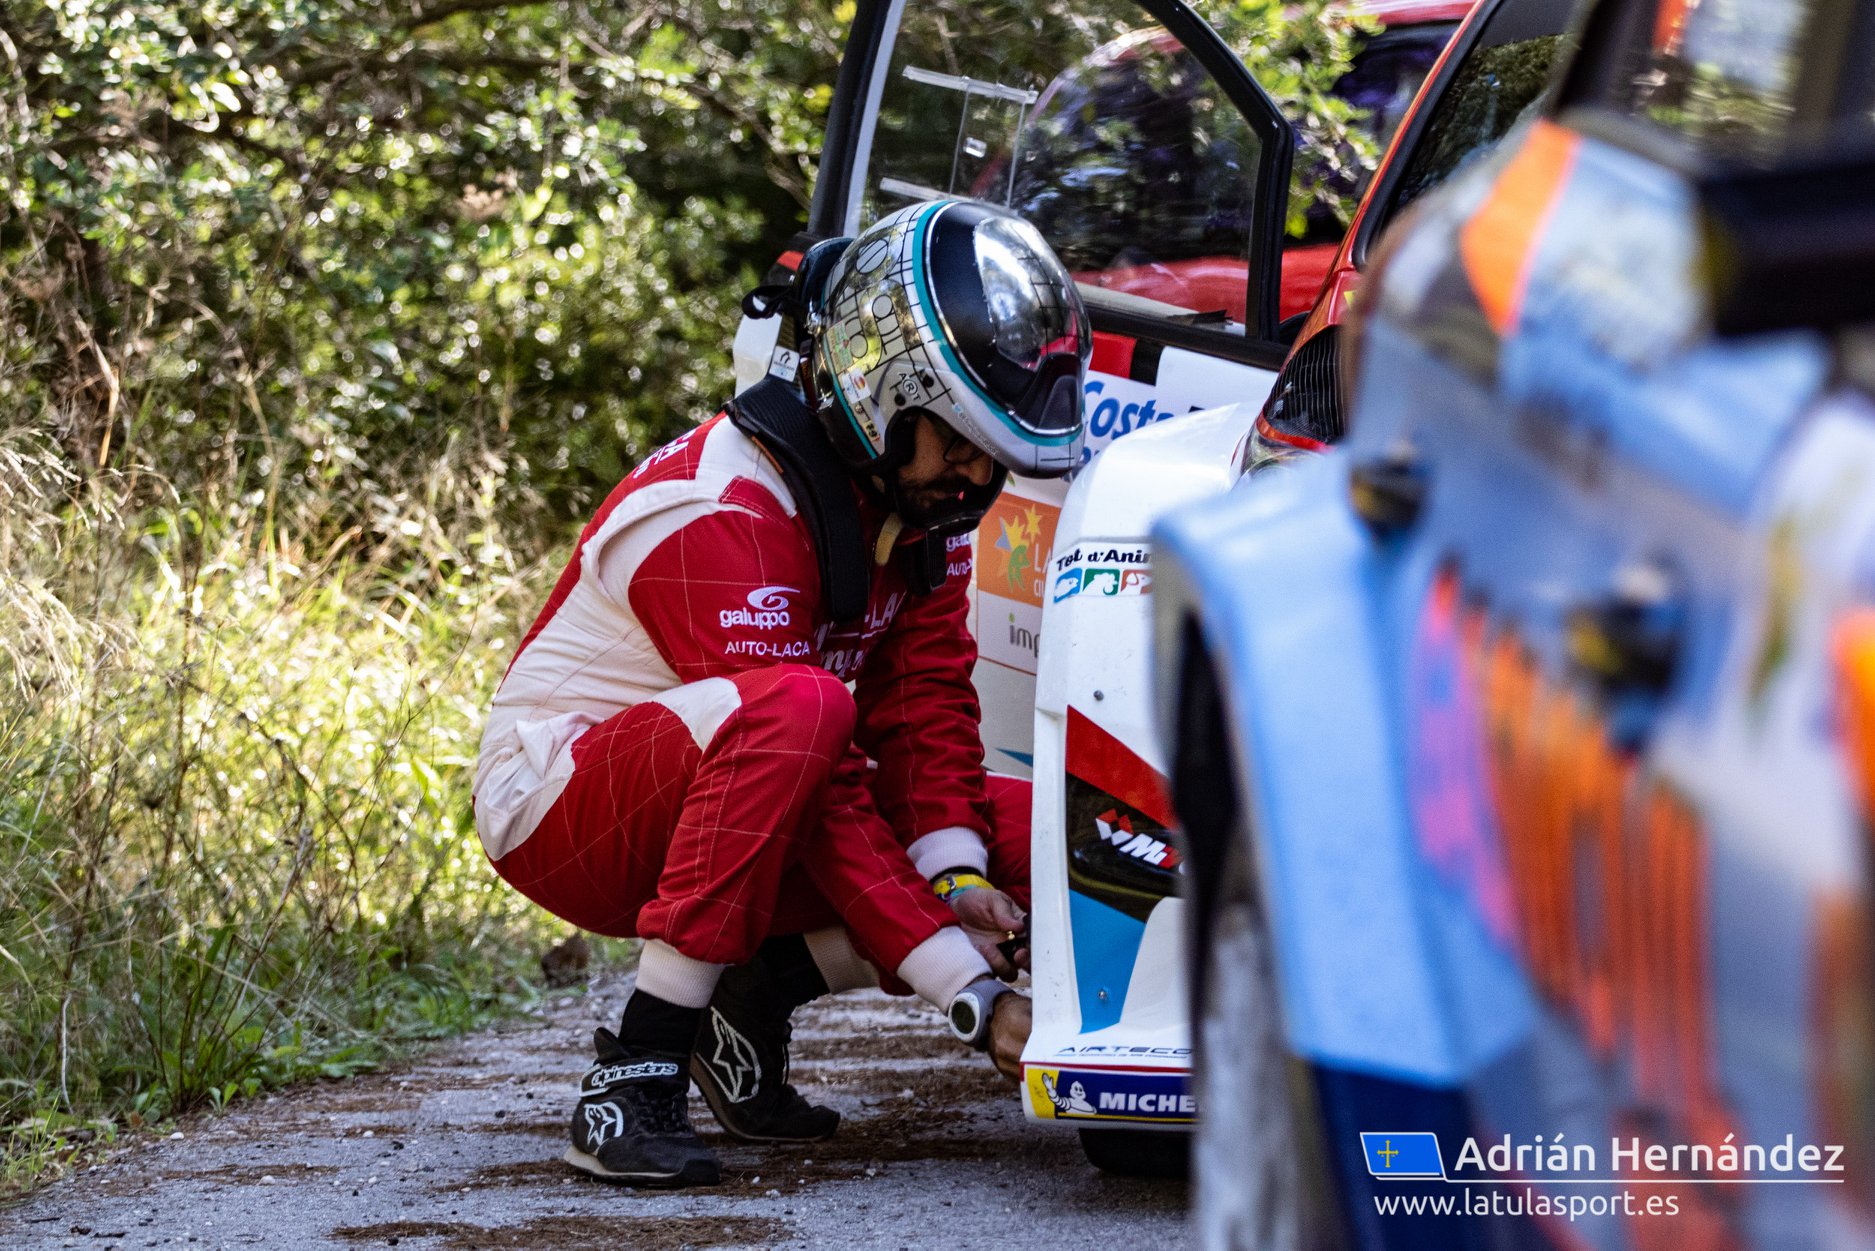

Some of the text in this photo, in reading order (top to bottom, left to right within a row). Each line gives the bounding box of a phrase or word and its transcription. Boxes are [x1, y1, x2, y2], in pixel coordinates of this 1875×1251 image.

[1084, 381, 1175, 441] ost
[1056, 548, 1082, 571] Tot
[719, 607, 790, 630] galuppo
[724, 641, 810, 657] AUTO-LACA
[591, 1061, 679, 1087] alpinestars
[1099, 1092, 1197, 1113] MICHE
